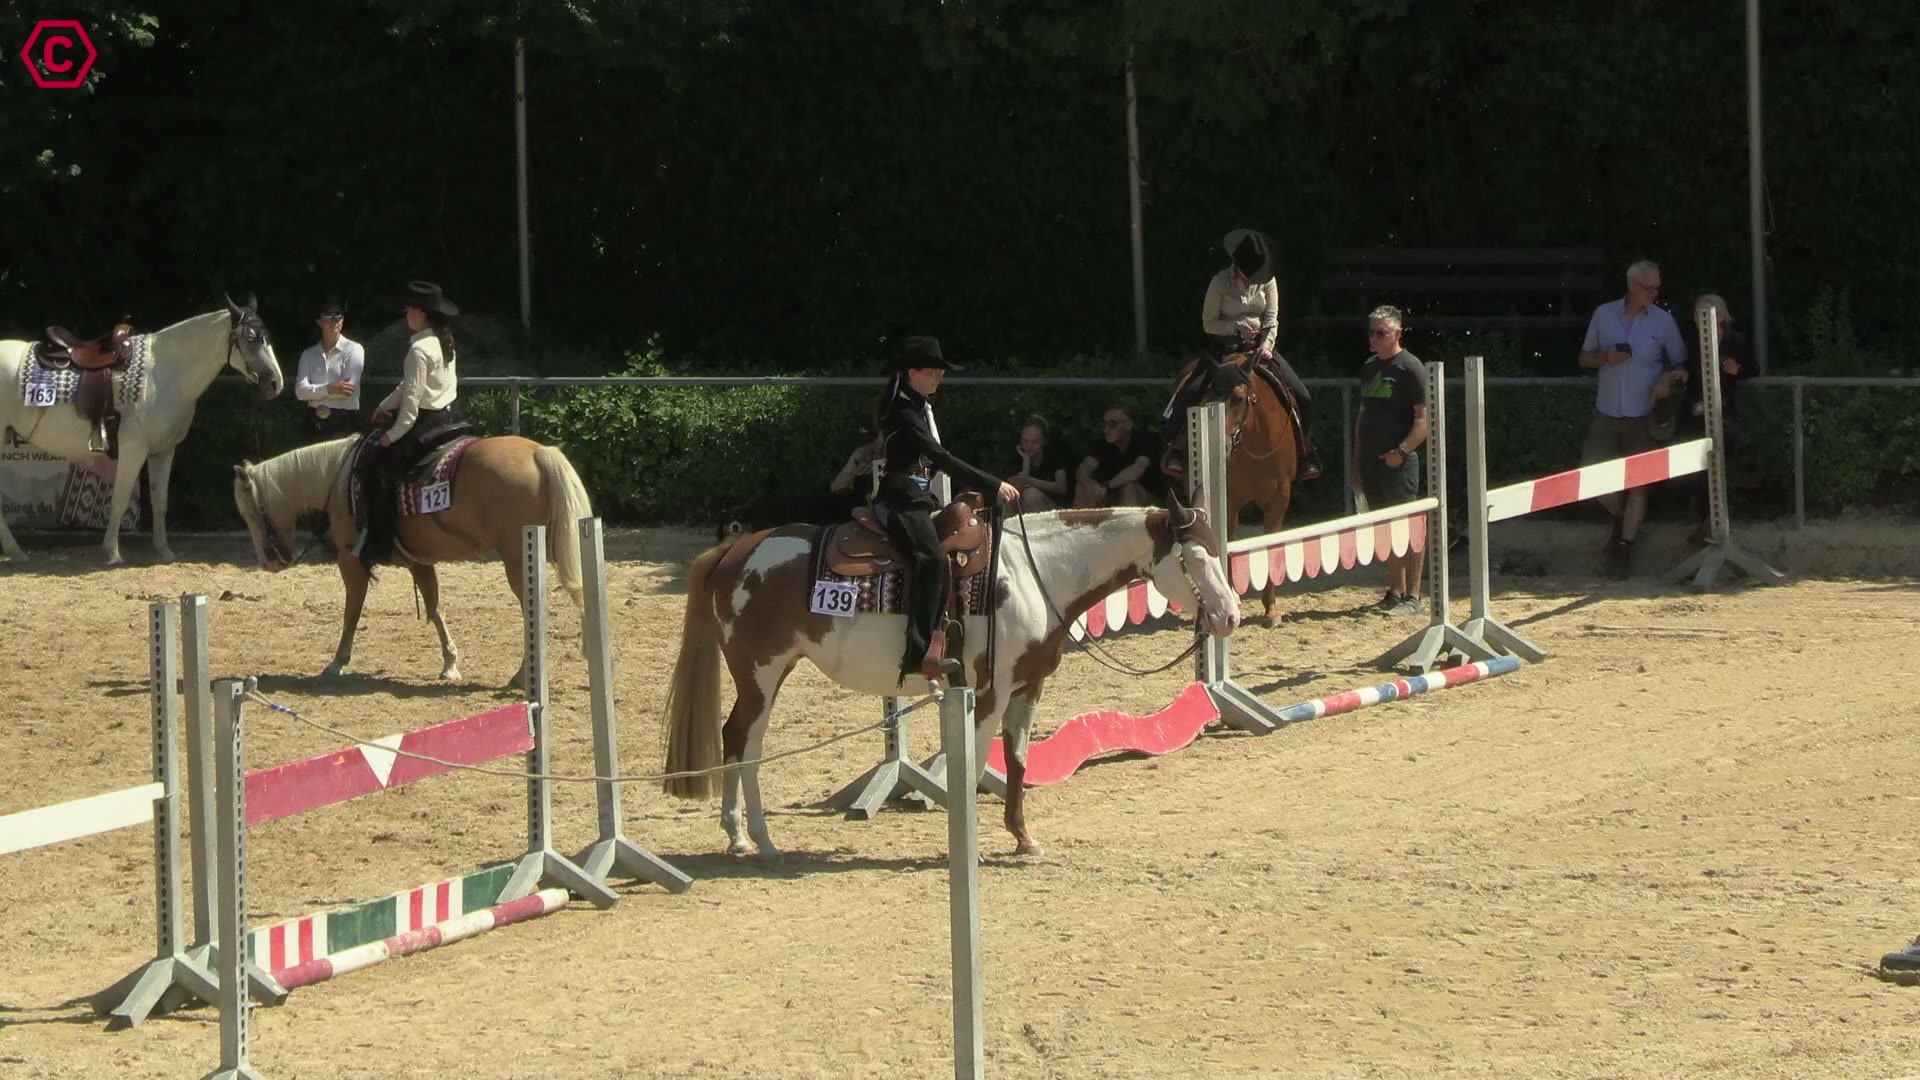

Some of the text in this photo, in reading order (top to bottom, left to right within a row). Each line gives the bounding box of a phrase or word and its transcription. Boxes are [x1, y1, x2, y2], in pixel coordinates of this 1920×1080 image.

[29, 388, 53, 403] 163
[425, 487, 447, 509] 127
[817, 588, 853, 612] 139
